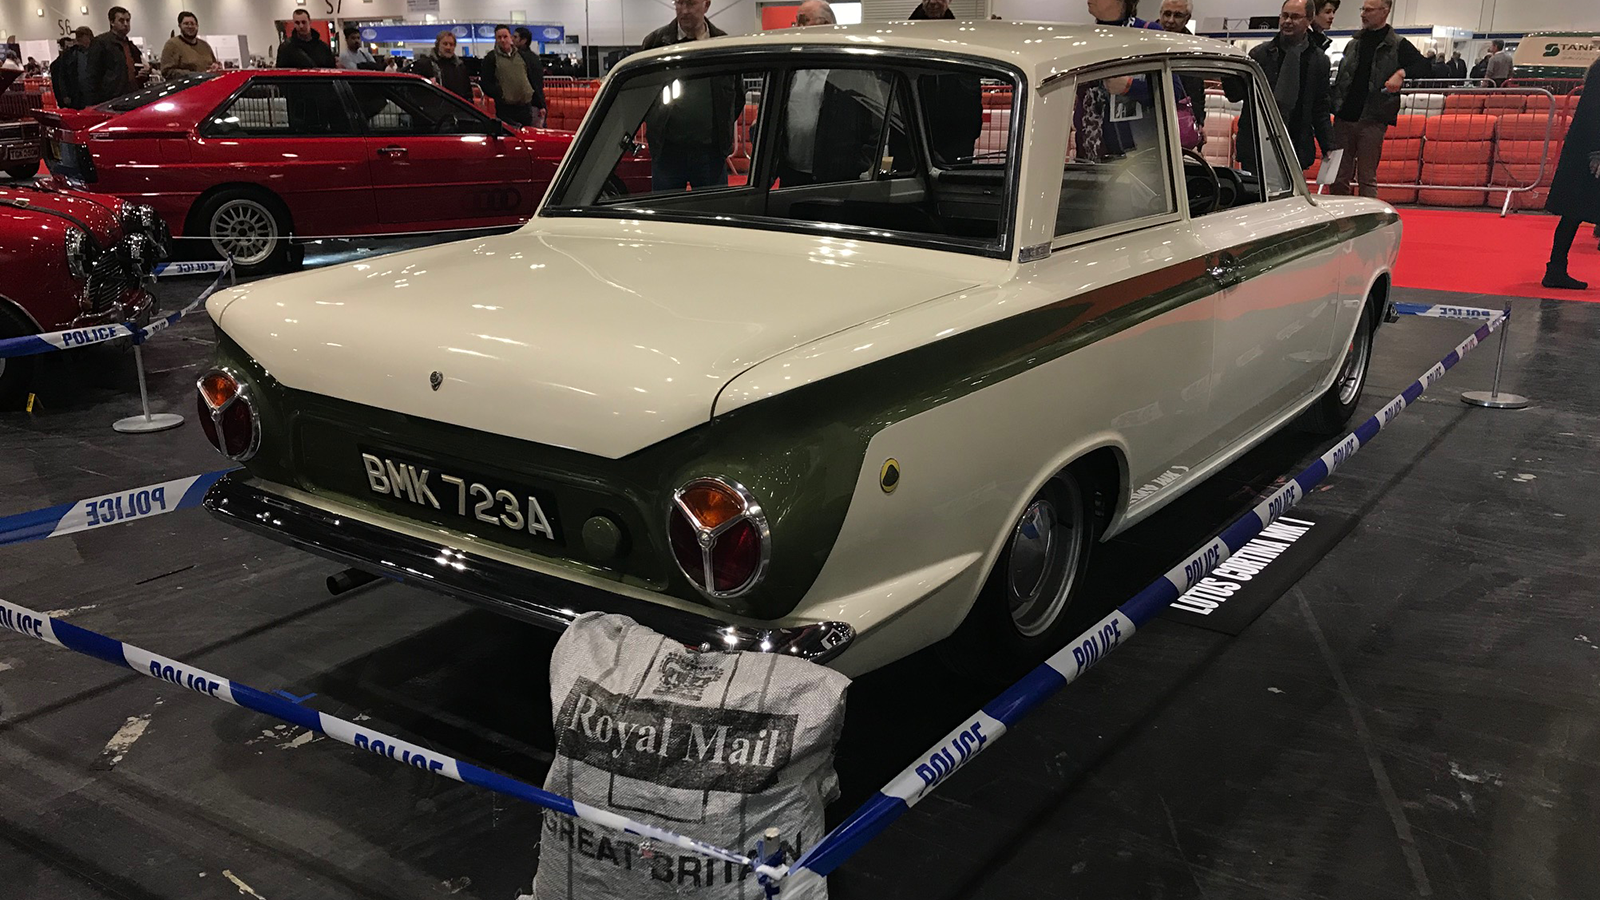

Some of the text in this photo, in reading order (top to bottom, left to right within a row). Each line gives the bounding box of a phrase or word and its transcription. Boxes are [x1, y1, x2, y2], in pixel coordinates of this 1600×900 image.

[58, 19, 71, 35] S6
[62, 327, 117, 346] POLICE
[362, 452, 555, 540] BMK 723A
[1268, 485, 1296, 520] POLICE
[1169, 577, 1242, 616] LOTUS
[1211, 538, 1291, 581] CORTINA
[1258, 521, 1310, 542] MK
[1184, 543, 1220, 586] POLICE
[1072, 618, 1121, 679] POLICE
[568, 693, 780, 768] Royal Mail
[914, 721, 987, 798] POLICE
[544, 808, 635, 871] GREAT
[650, 831, 802, 888] BRITAN
